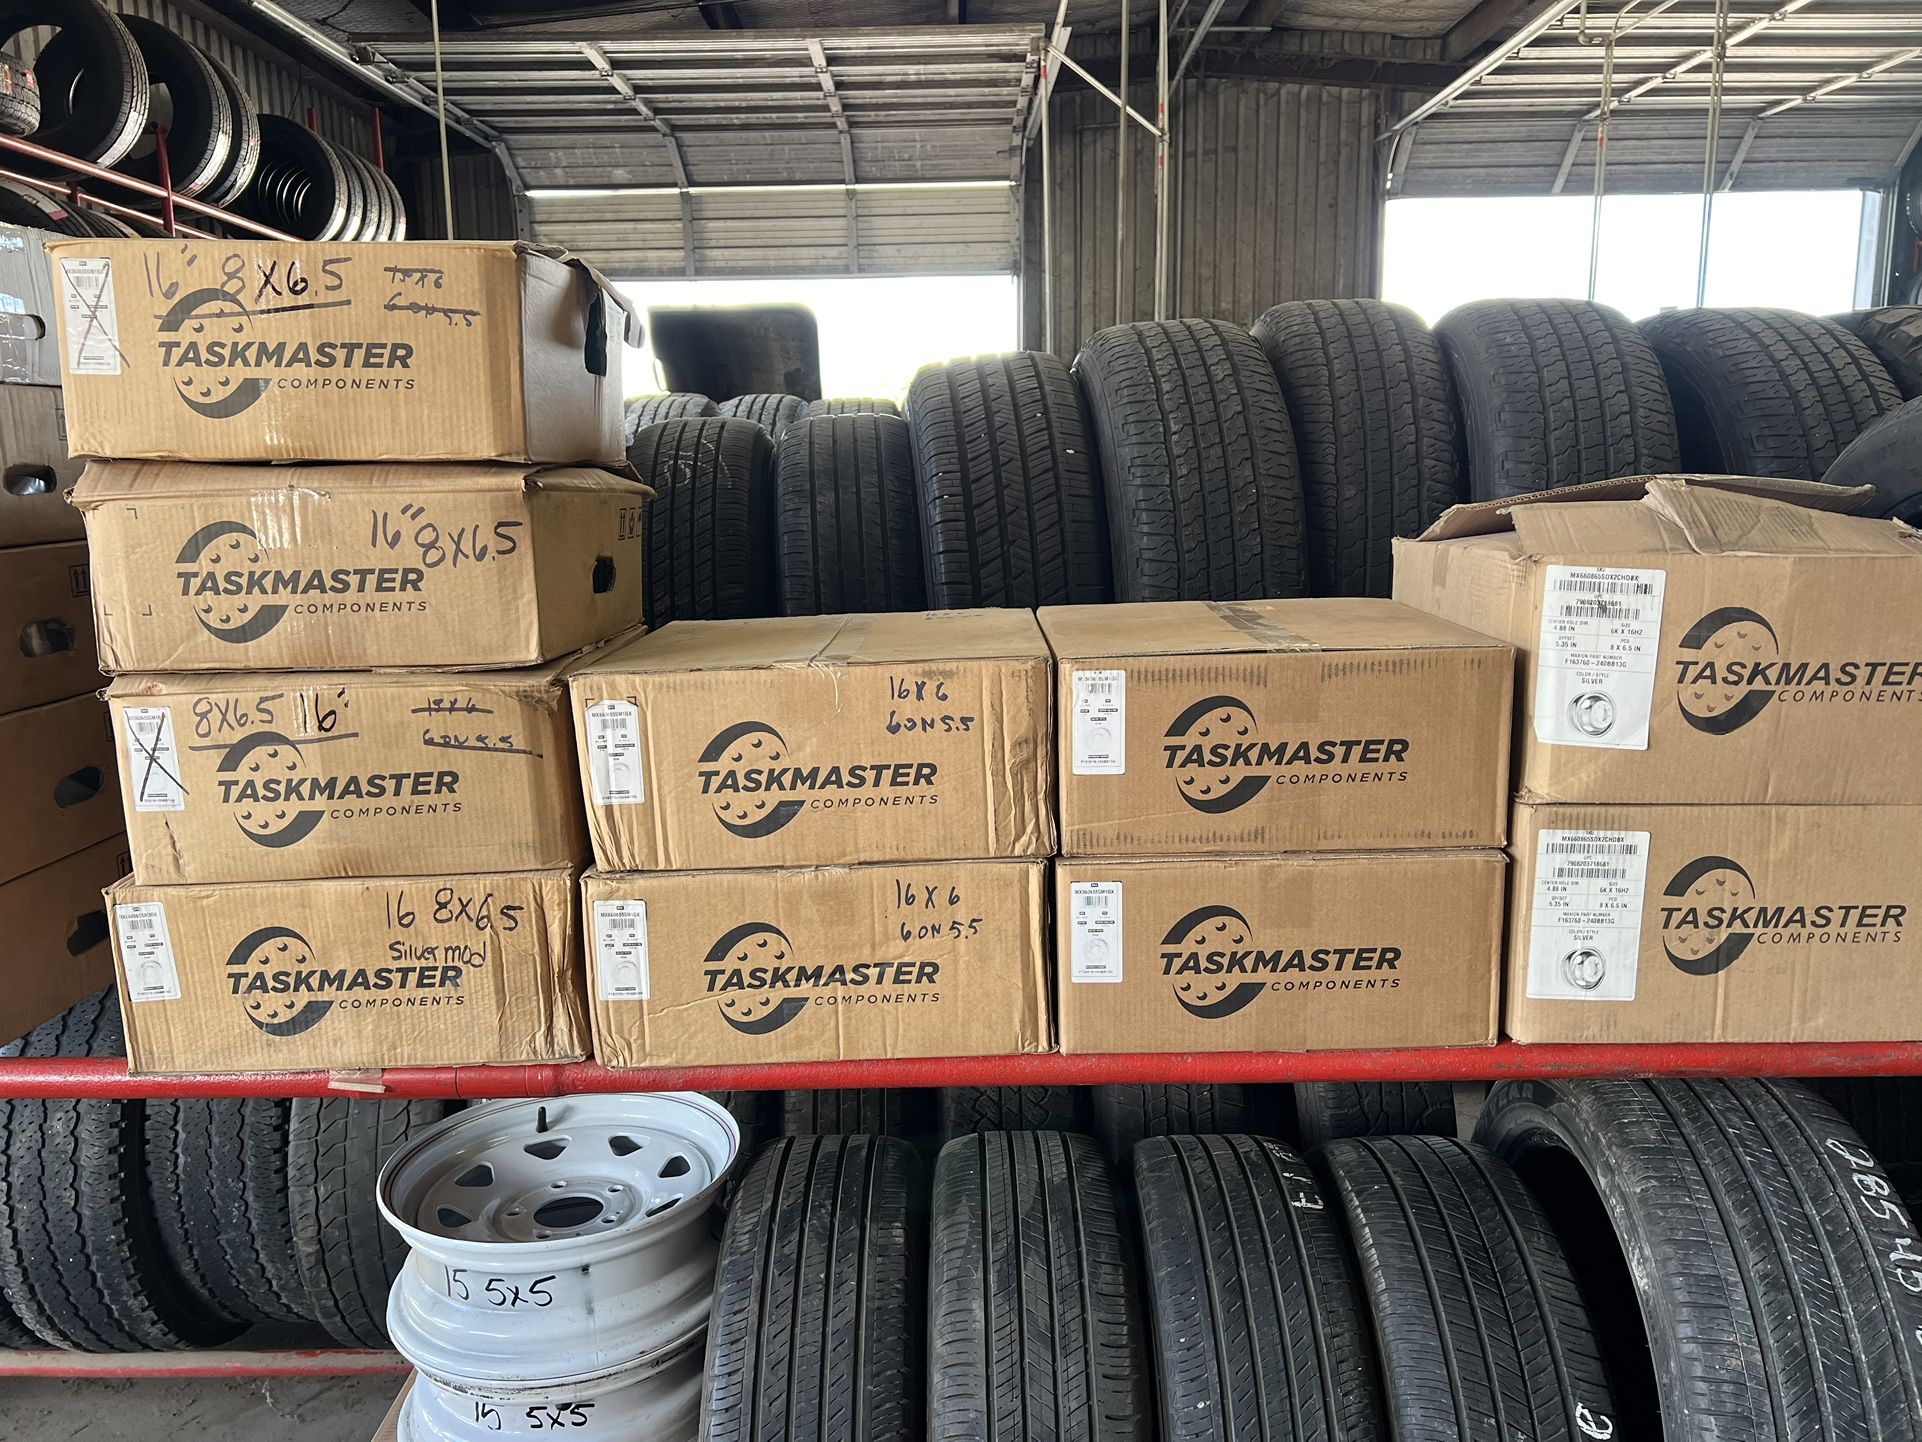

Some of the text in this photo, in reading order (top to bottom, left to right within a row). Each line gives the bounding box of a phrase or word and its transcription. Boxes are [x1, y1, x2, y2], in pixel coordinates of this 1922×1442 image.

[158, 341, 414, 368] TASKMASTER
[277, 378, 416, 390] COMPONENTS
[176, 567, 425, 596] TASKMASTER
[294, 601, 428, 615] COMPONENTS
[1581, 677, 1603, 685] SILVER
[1163, 738, 1409, 768] TASKMASTER
[217, 770, 460, 804] TASKMASTER
[697, 762, 938, 795] TASKMASTER
[1276, 771, 1408, 785] COMPONENTS
[331, 803, 462, 820] COMPONENTS
[811, 794, 938, 810] COMPONENTS
[386, 890, 416, 929] 16
[1660, 904, 1907, 930] TASKMASTER
[1757, 931, 1902, 944] COMPONENTS
[1160, 947, 1402, 975] TASKMASTER
[226, 965, 463, 995] TASKMASTER
[703, 961, 940, 992] TASKMASTER
[1271, 978, 1400, 992] COMPONENTS
[339, 995, 465, 1010] COMPONENTS
[815, 992, 940, 1006] COMPONENTS
[445, 1264, 470, 1301] 15
